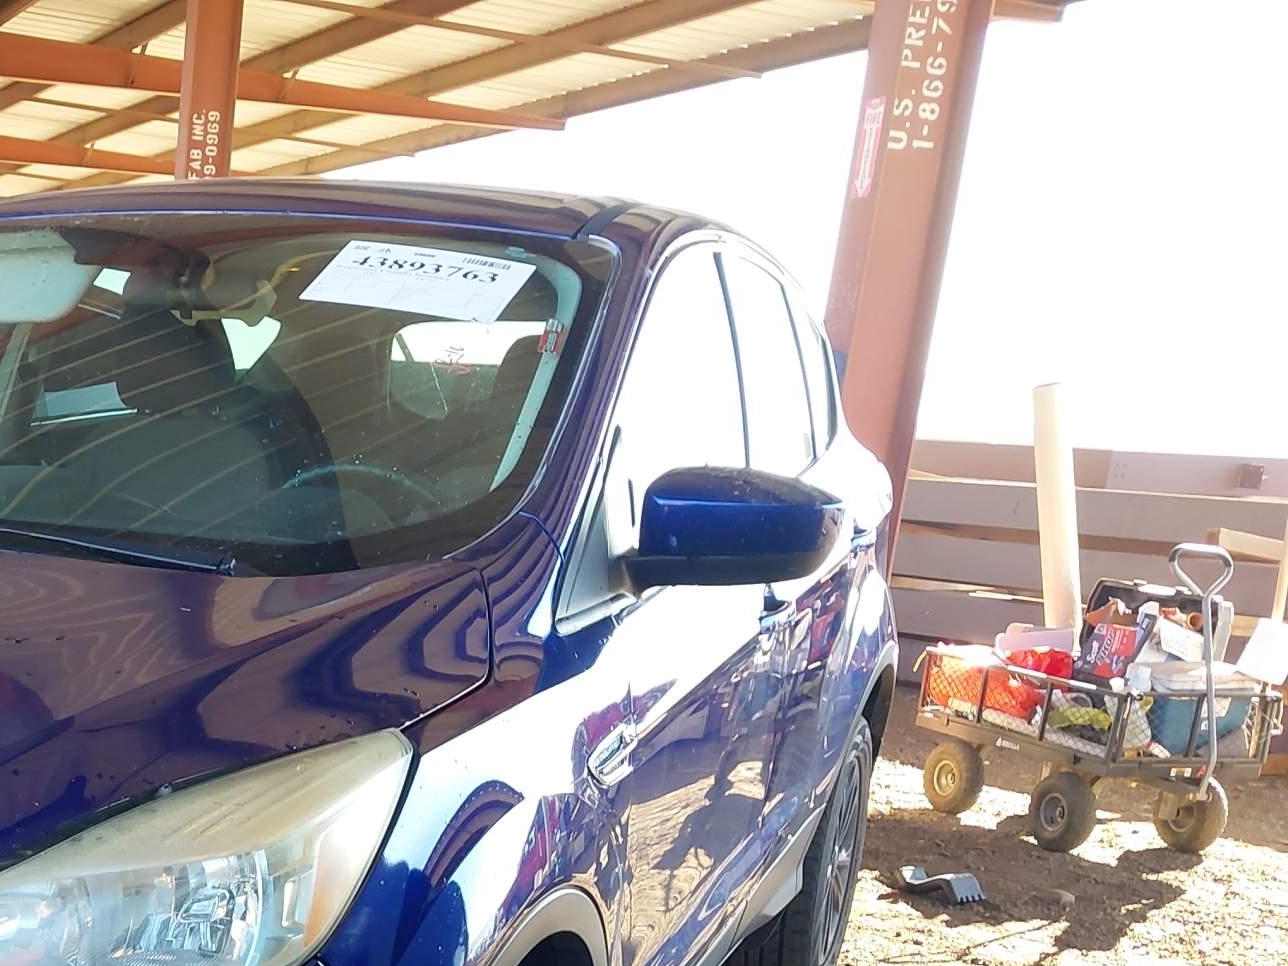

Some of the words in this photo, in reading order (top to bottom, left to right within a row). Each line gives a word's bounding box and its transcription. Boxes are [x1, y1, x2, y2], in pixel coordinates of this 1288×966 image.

[901, 0, 931, 69] PRE
[191, 109, 206, 141] INC.
[203, 110, 220, 179] 9-0969
[887, 88, 916, 150] U.S.
[352, 255, 499, 284] 43893763
